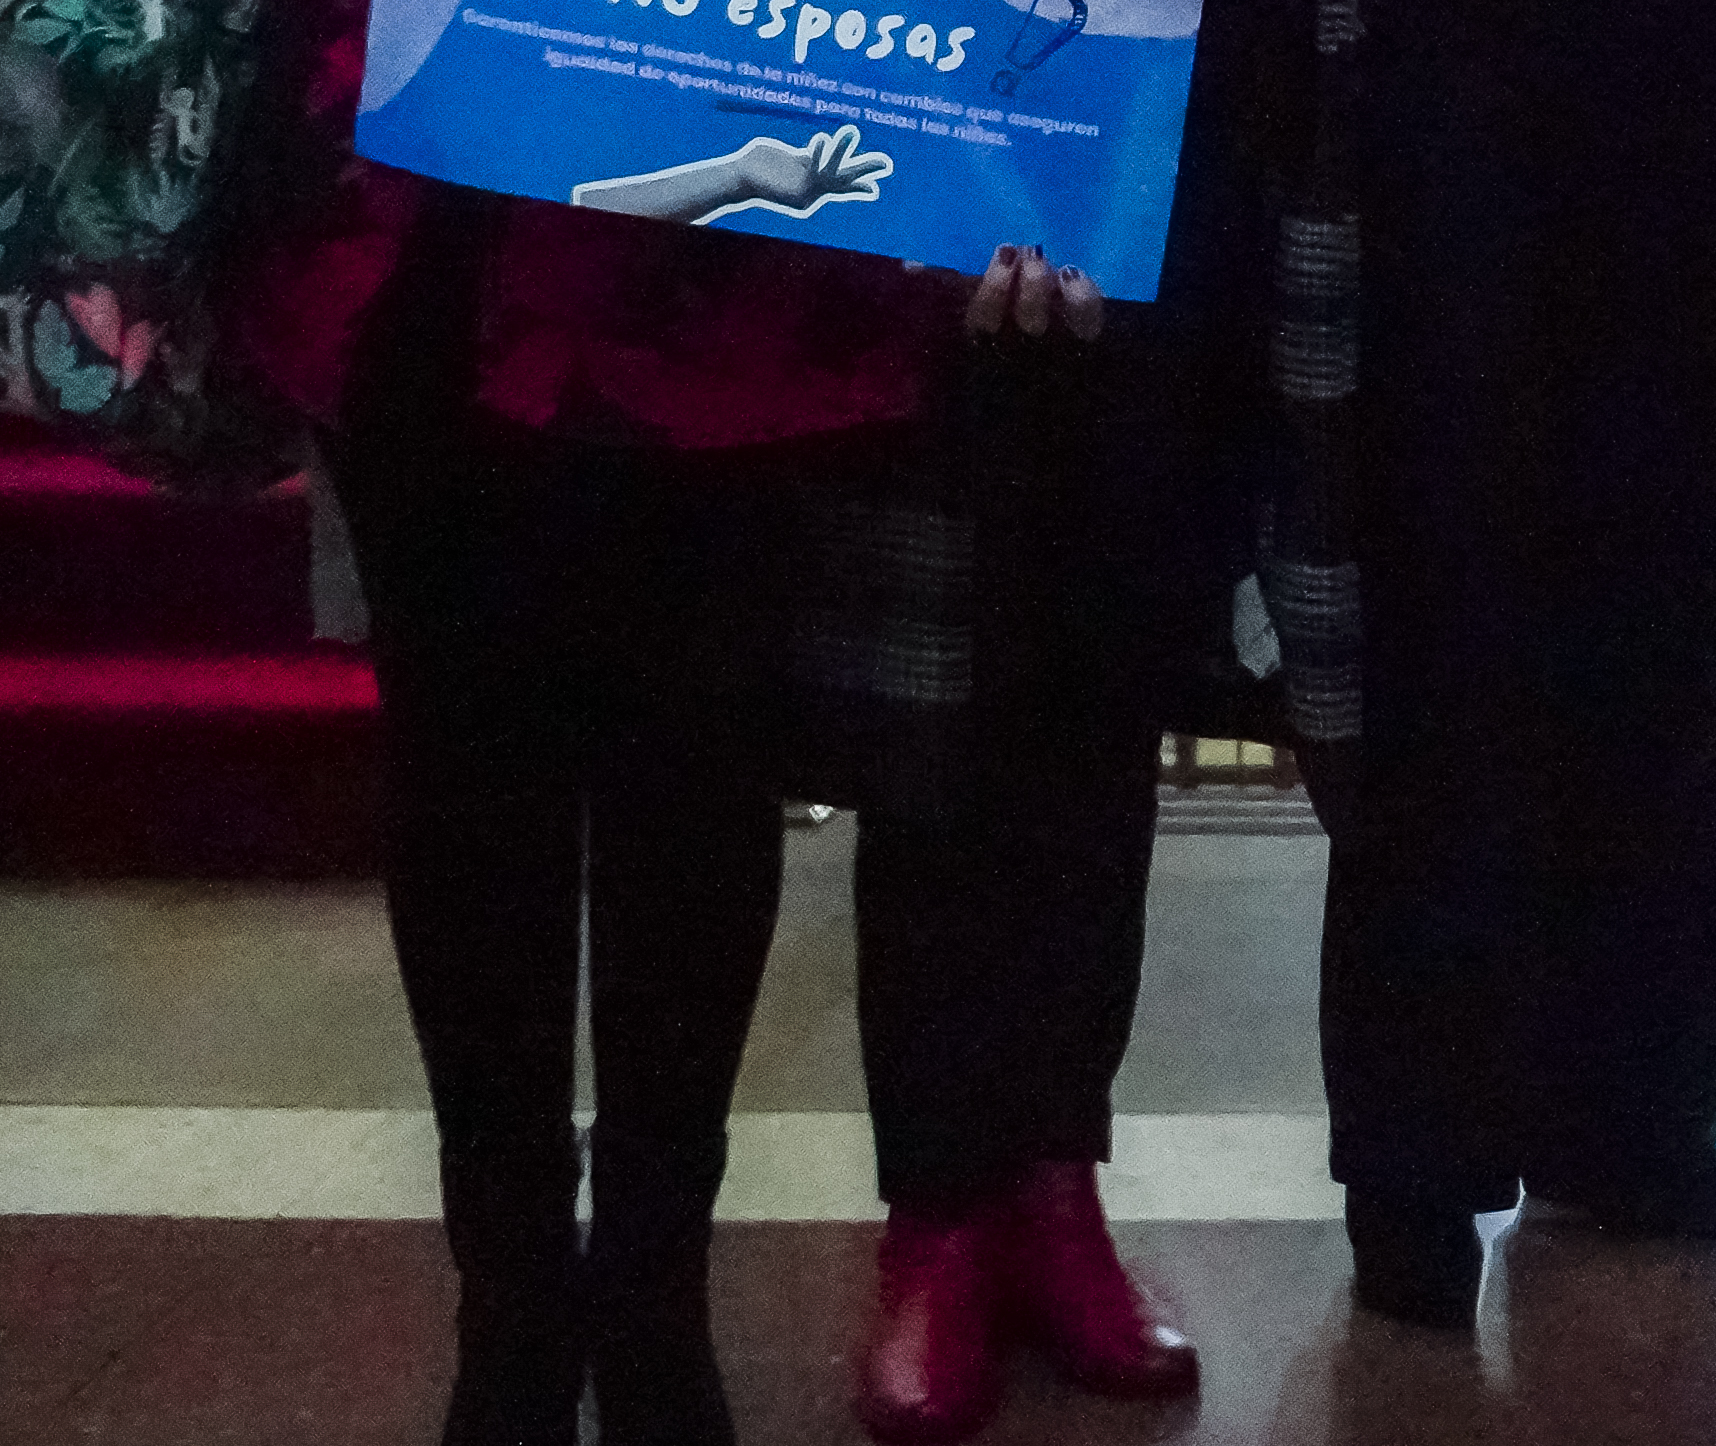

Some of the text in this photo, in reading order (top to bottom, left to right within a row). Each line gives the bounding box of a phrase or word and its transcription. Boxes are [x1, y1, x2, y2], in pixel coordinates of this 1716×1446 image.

[543, 45, 636, 76] igualdad
[638, 65, 664, 80] de
[667, 71, 814, 109] oportunidades
[815, 99, 861, 119] para
[966, 107, 1004, 124] que
[1008, 112, 1099, 137] aseguren
